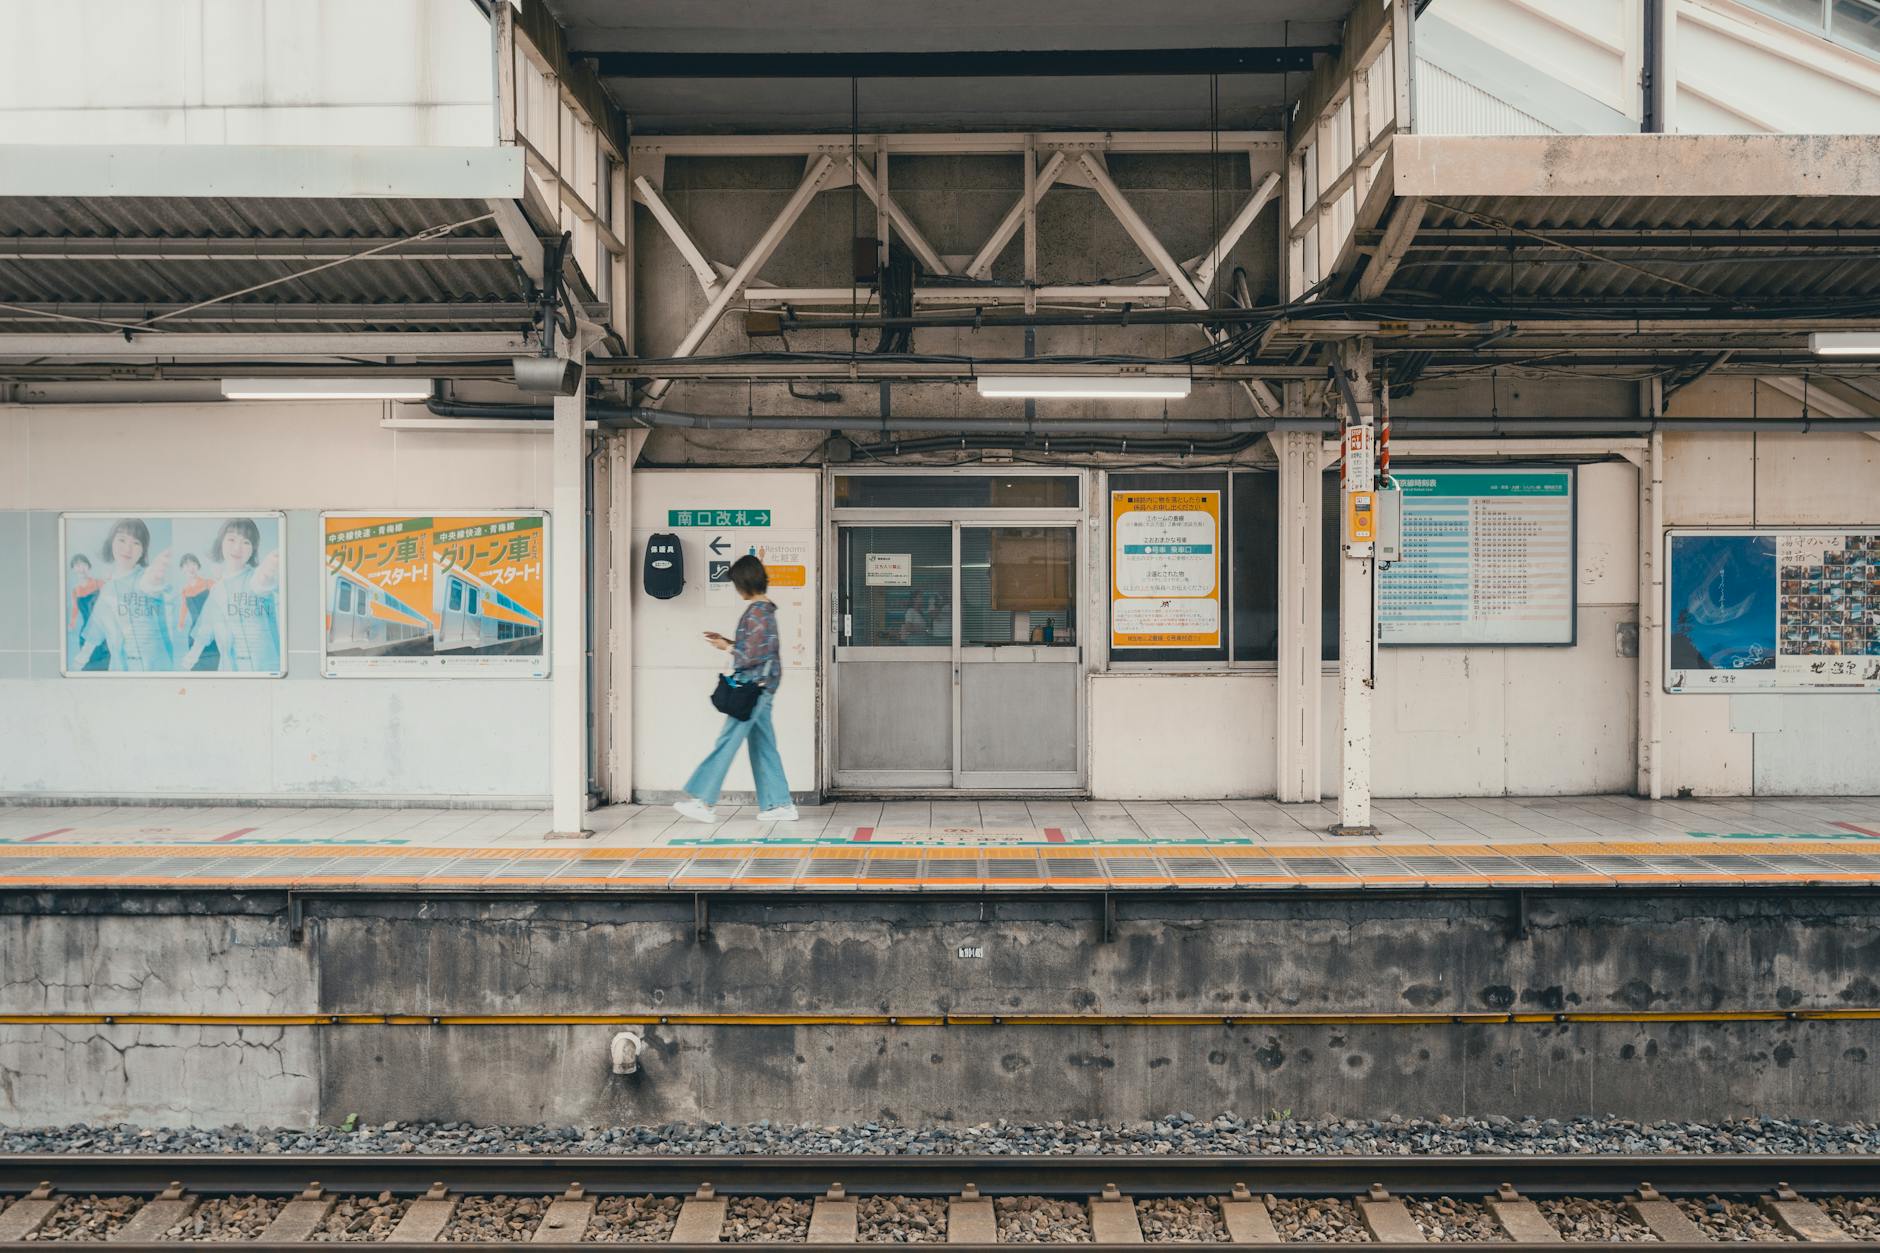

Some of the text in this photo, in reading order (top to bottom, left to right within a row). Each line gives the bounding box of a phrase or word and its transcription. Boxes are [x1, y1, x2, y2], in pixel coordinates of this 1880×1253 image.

[677, 511, 750, 526] 南口改札
[329, 536, 419, 576] グリーン車
[440, 535, 531, 575] グリーン車
